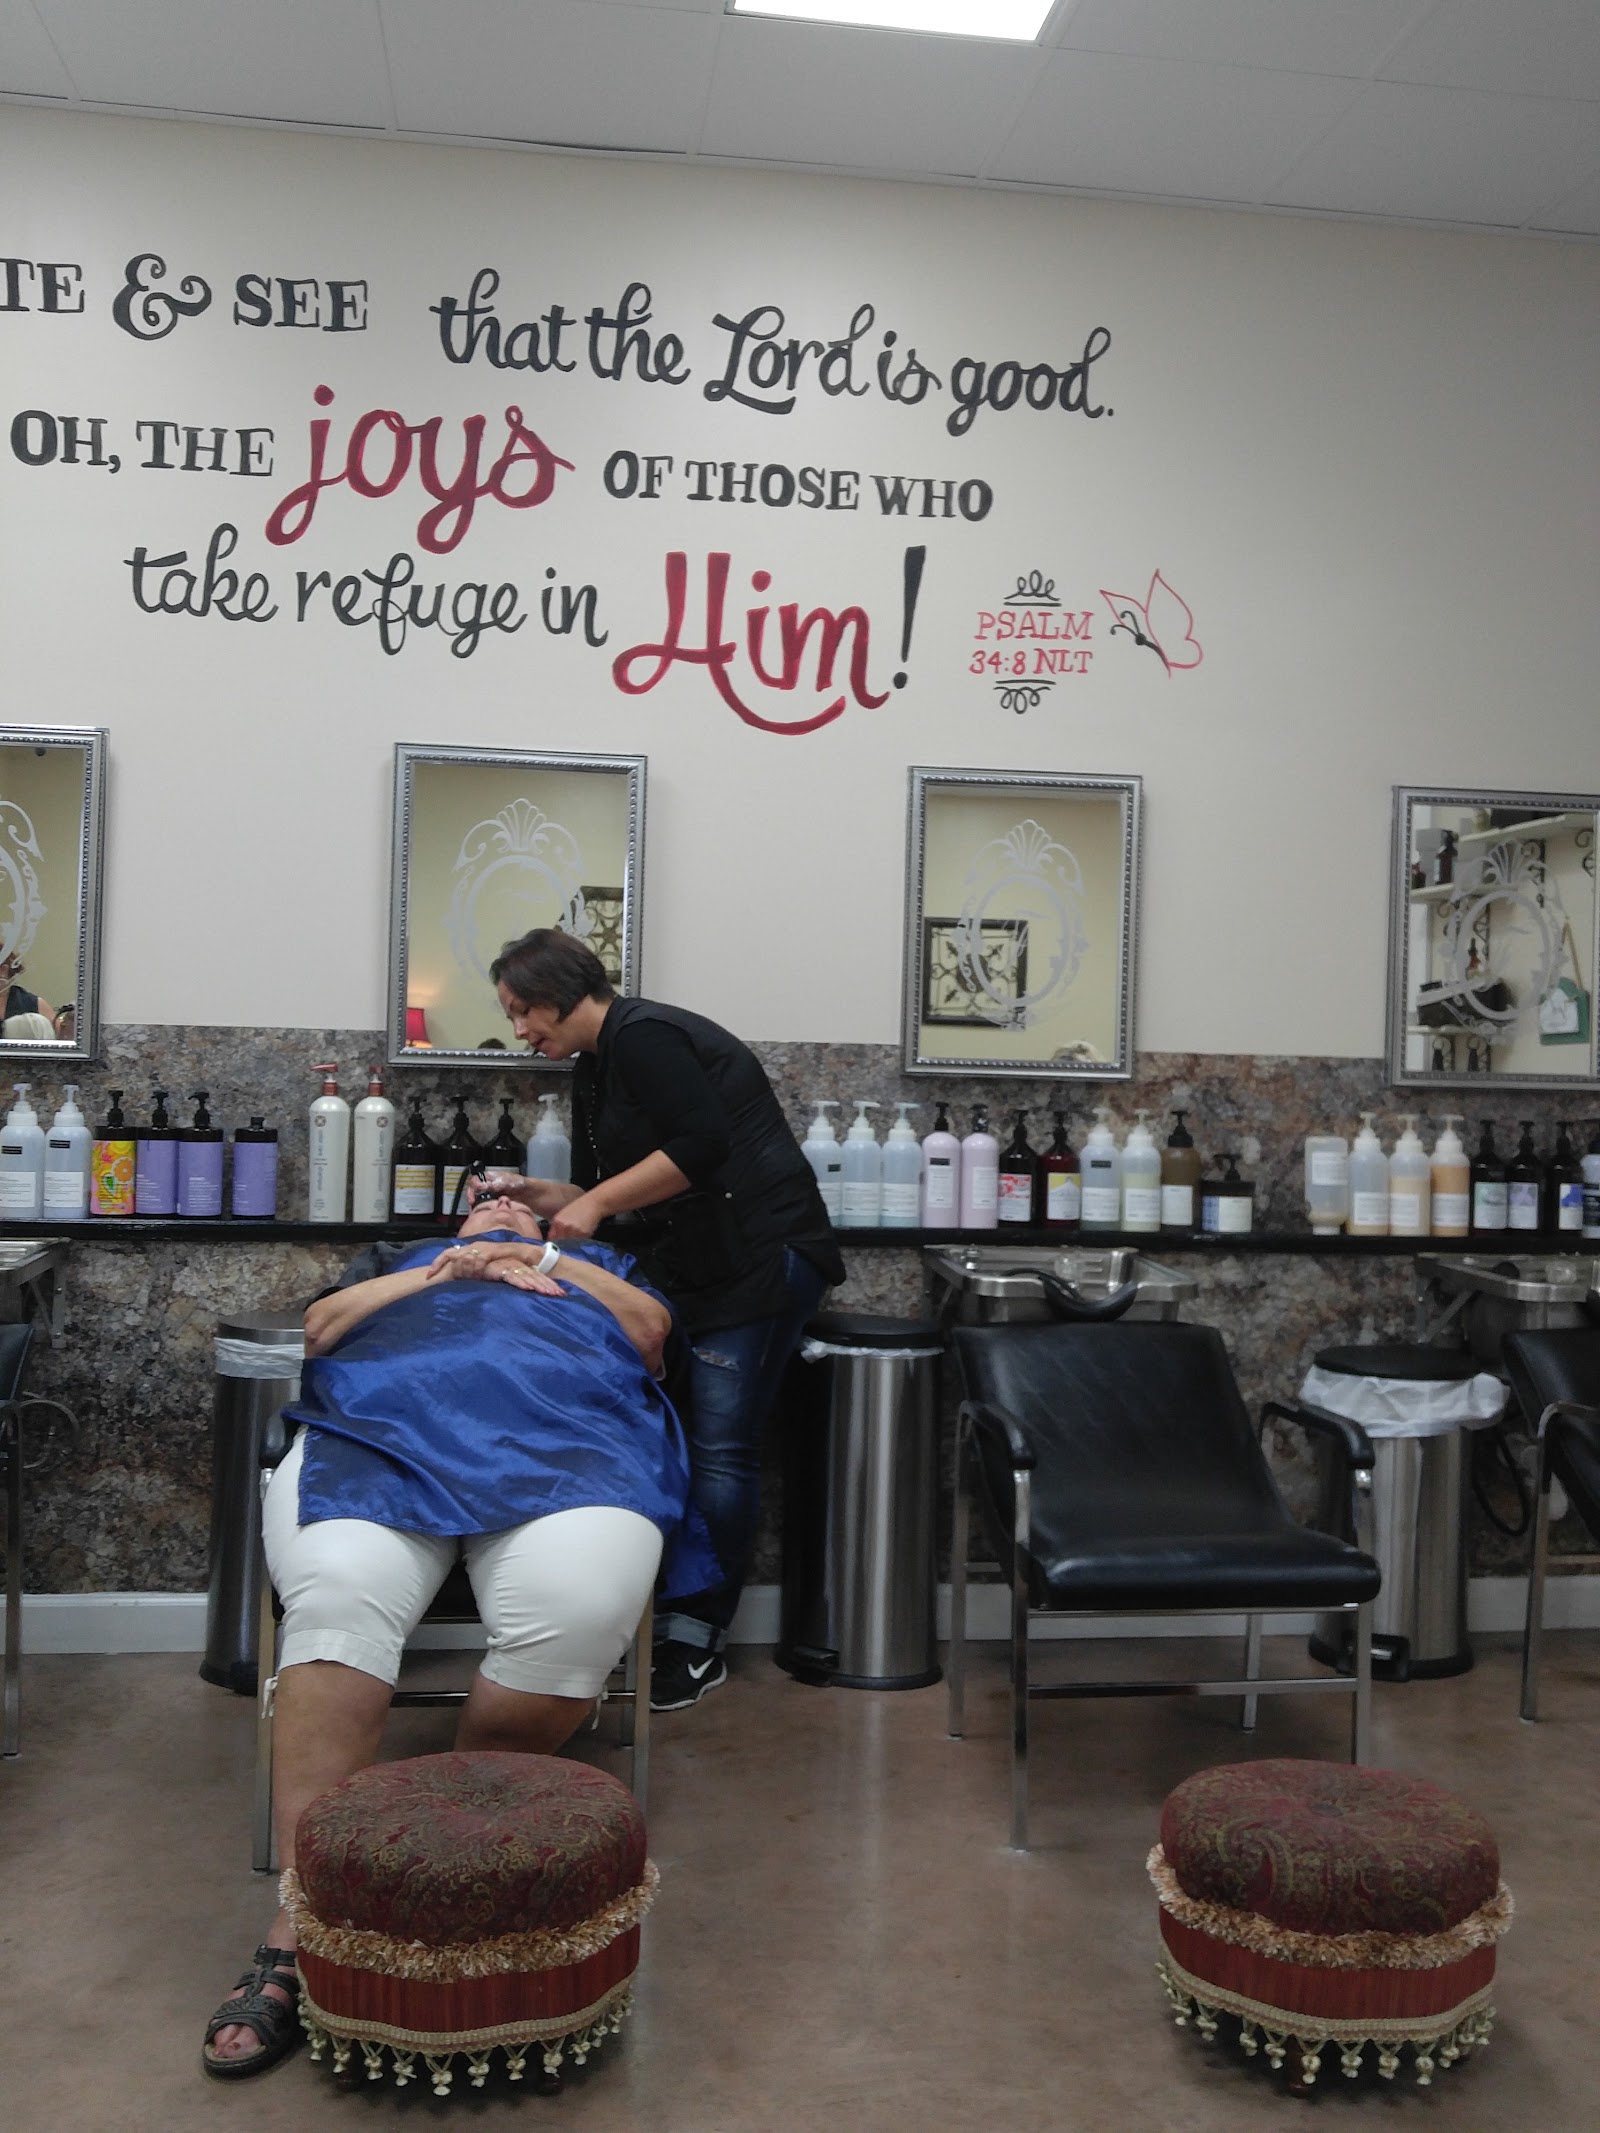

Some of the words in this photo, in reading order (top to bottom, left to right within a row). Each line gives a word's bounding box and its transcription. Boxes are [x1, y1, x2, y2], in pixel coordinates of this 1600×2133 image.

[112, 252, 212, 340] &
[233, 273, 368, 332] SEE
[429, 268, 577, 372] that
[584, 282, 691, 385] the
[703, 303, 875, 415] Lord
[876, 331, 942, 405] is
[946, 326, 1115, 437] good.
[10, 409, 122, 474] OH,
[136, 420, 274, 477] THE
[264, 384, 576, 554] joys
[603, 450, 673, 500] OF
[685, 459, 860, 511] THOSE
[869, 473, 993, 522] WHO
[123, 522, 279, 622] take
[296, 552, 528, 659] refuge
[541, 567, 609, 648] in
[612, 544, 926, 736] Him!
[969, 650, 1027, 676] 34:8
[1032, 647, 1094, 675] NLT
[973, 610, 1095, 641] PSALM
